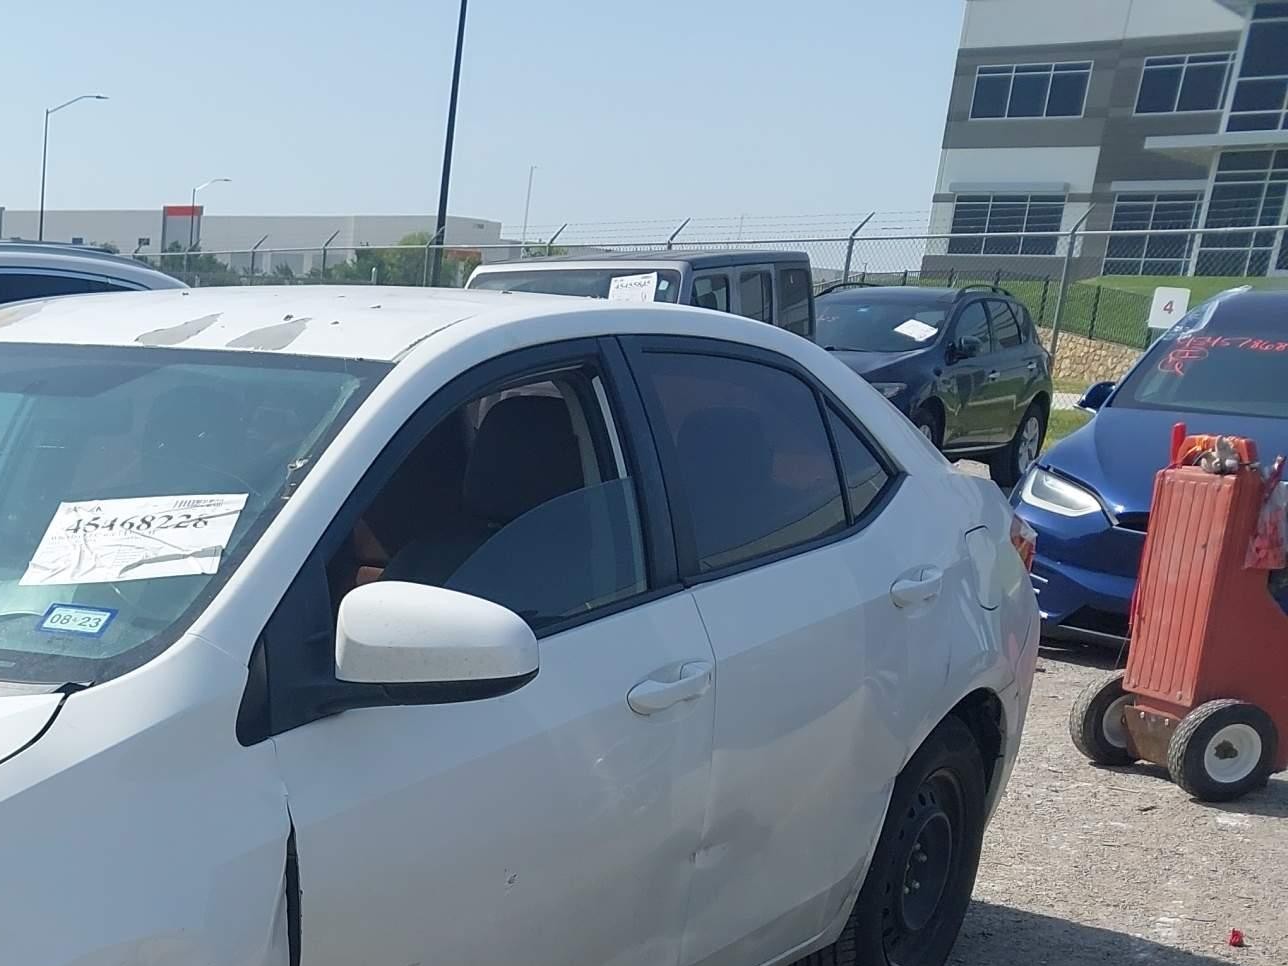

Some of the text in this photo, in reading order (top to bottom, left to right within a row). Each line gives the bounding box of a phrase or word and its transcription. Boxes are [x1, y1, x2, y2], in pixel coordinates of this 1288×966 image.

[1163, 300, 1174, 314] 4
[49, 613, 102, 629] 08 23
